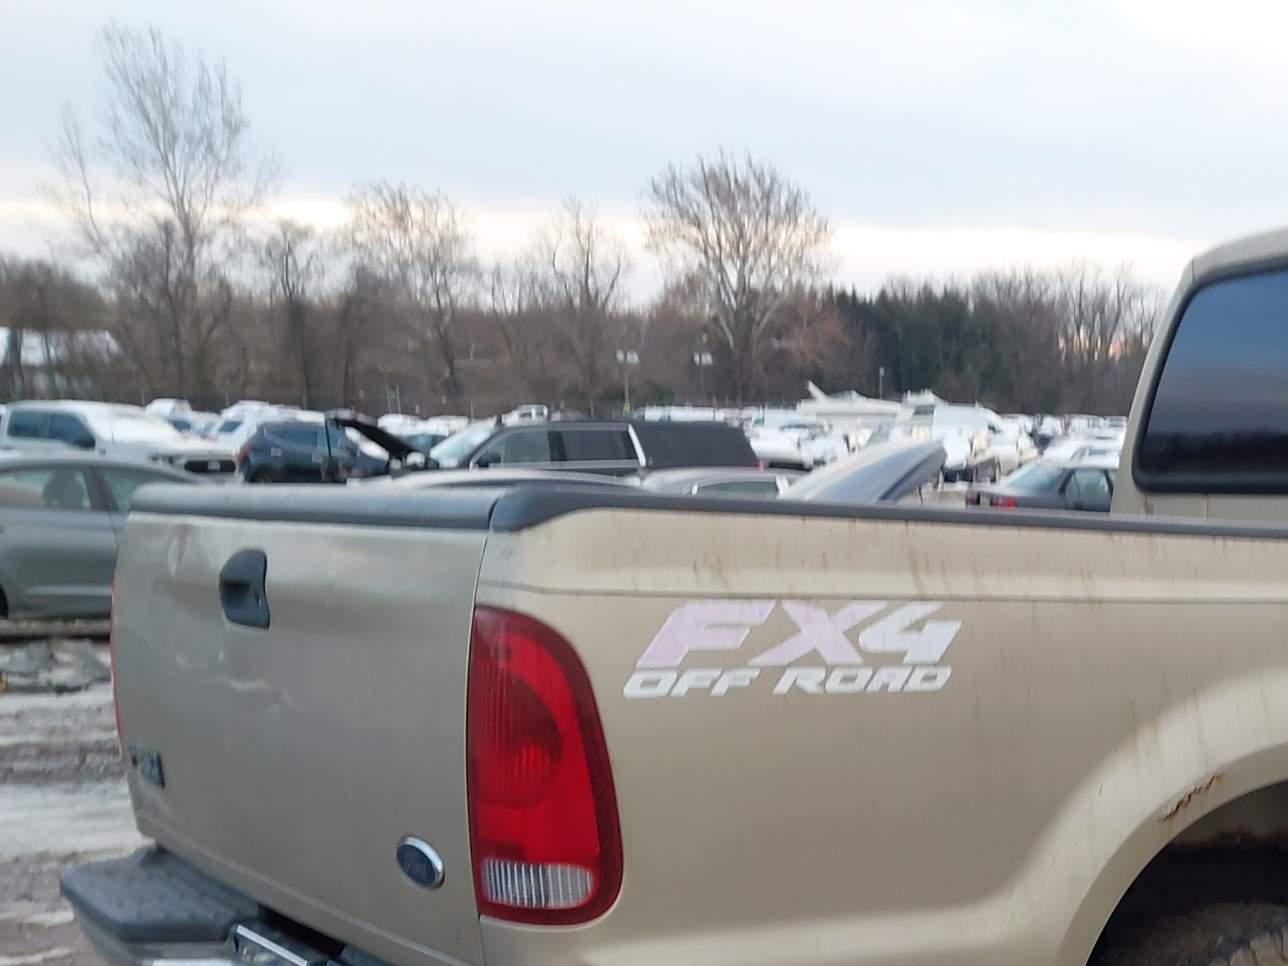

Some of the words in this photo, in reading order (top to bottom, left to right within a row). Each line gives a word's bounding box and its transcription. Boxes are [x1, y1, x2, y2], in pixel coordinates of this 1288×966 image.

[635, 599, 962, 668] FX4
[622, 667, 761, 698] OFF
[772, 665, 953, 696] ROAD
